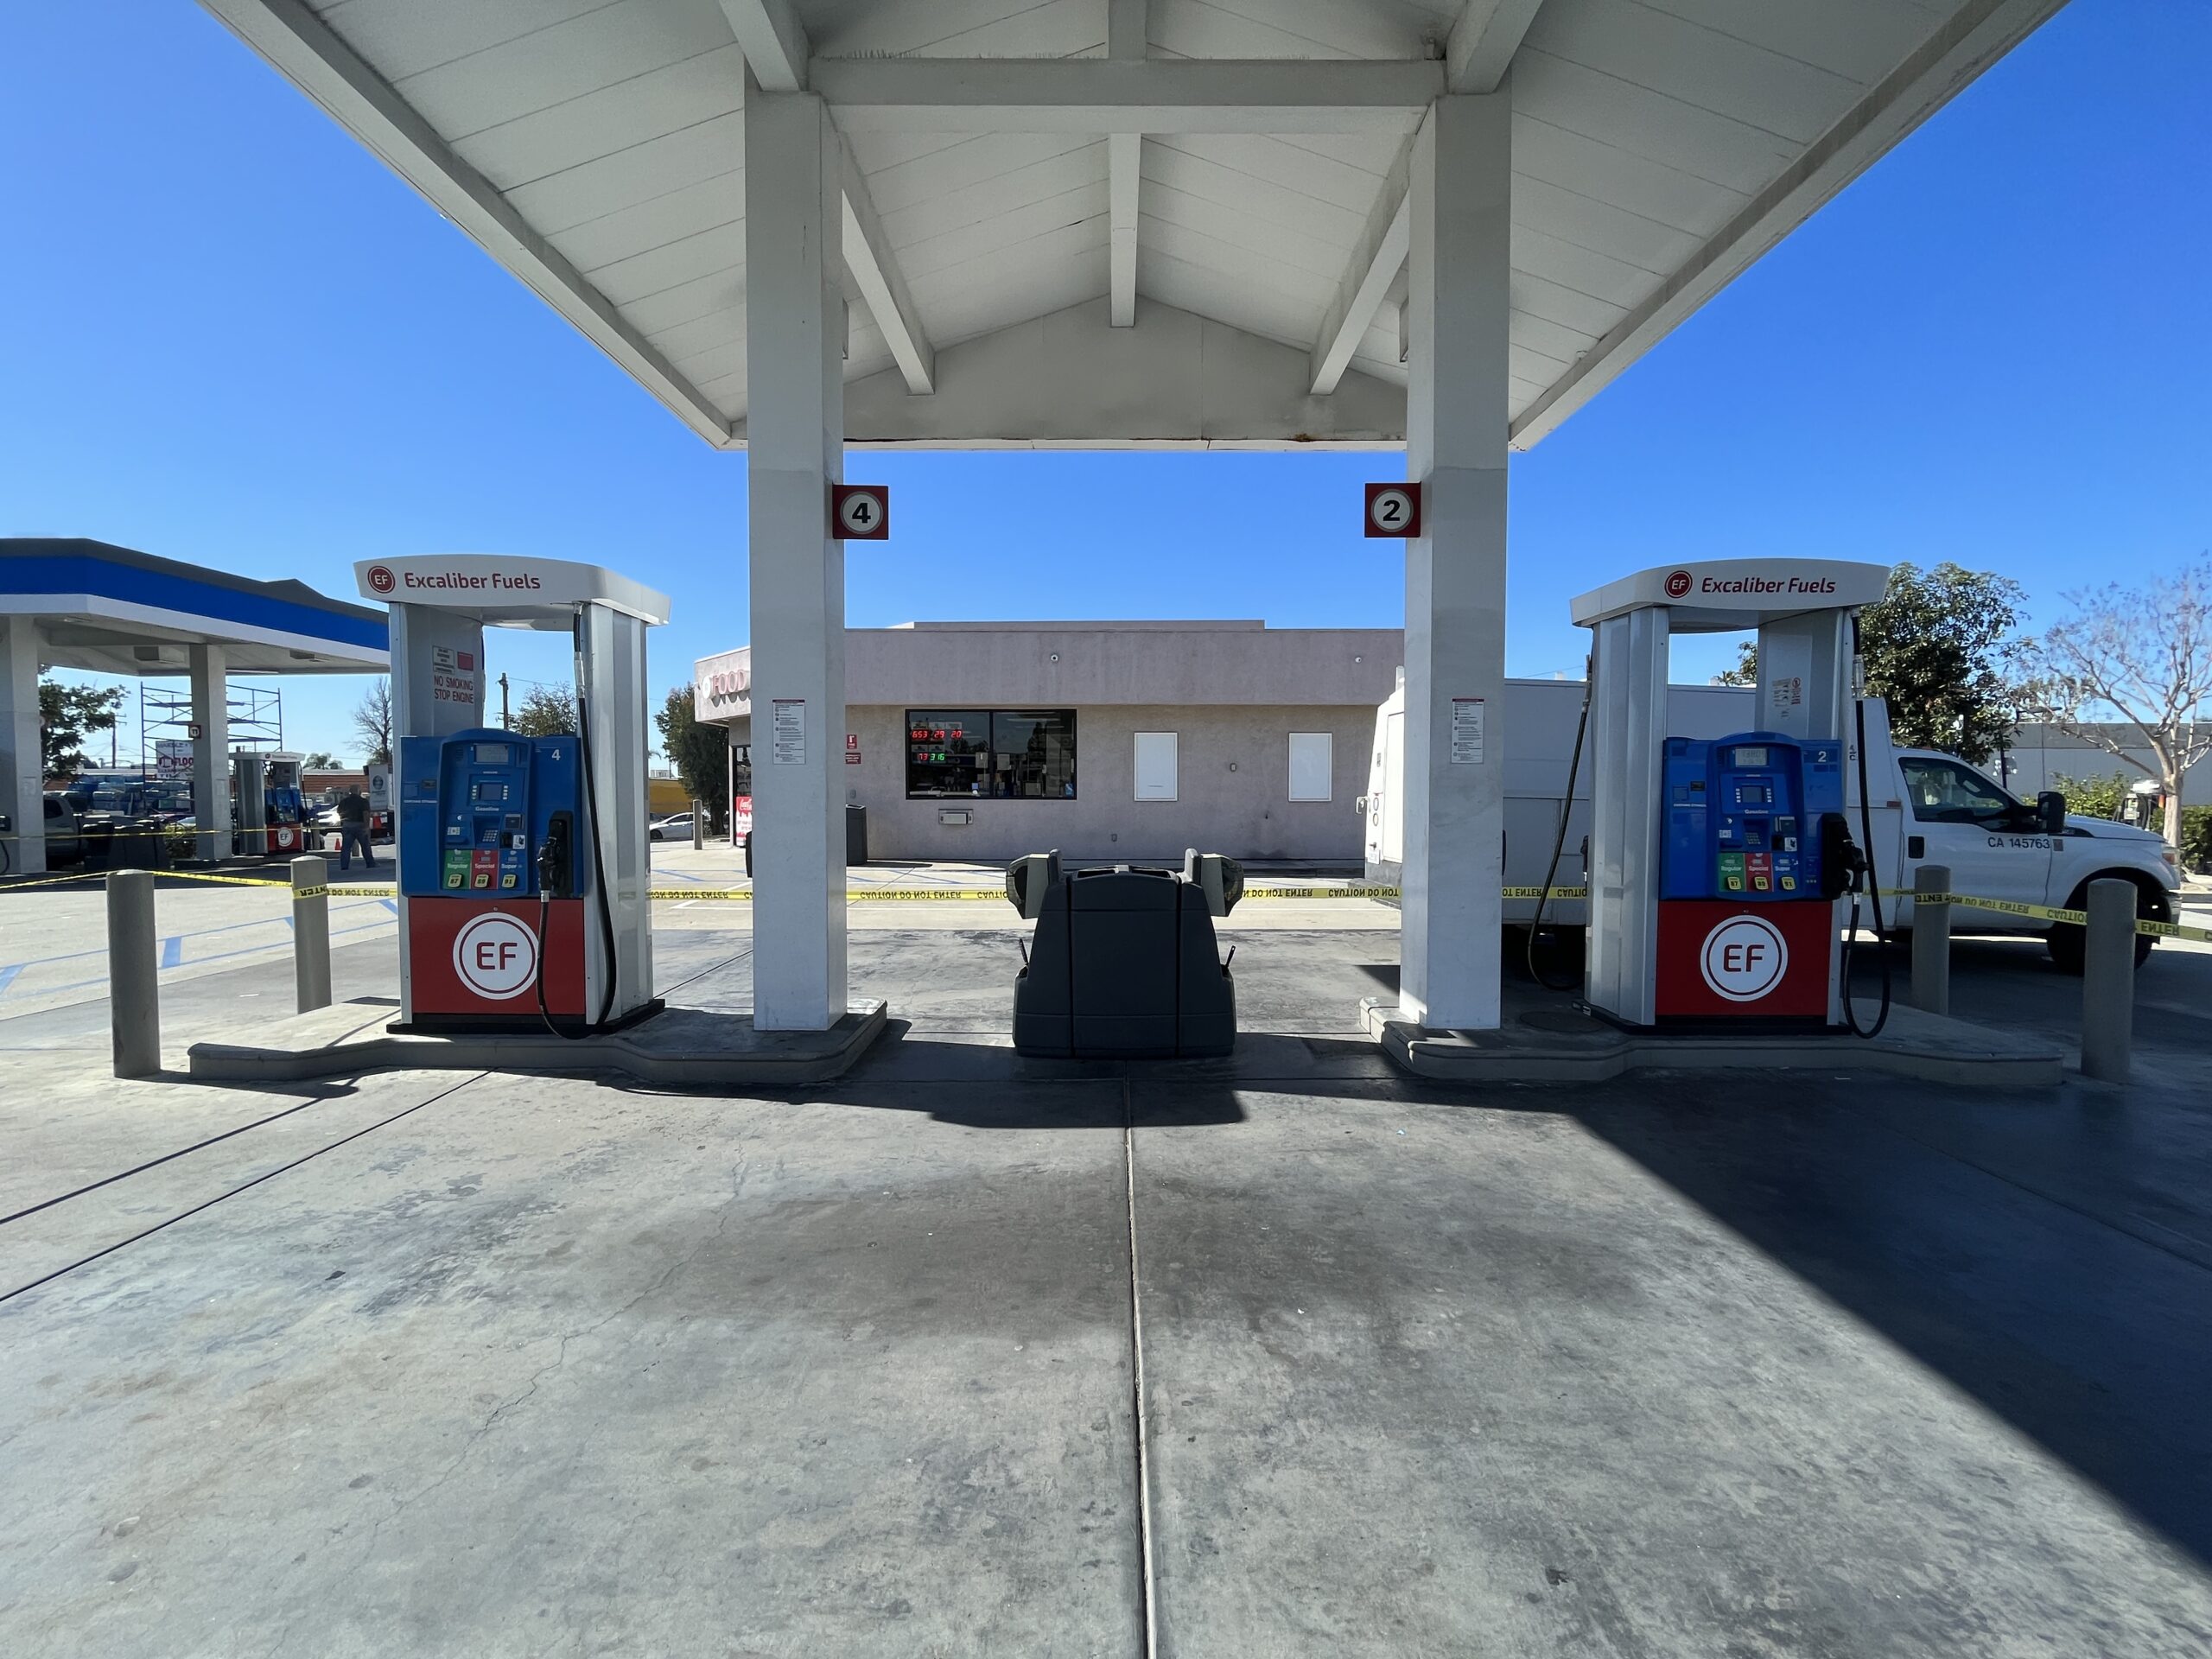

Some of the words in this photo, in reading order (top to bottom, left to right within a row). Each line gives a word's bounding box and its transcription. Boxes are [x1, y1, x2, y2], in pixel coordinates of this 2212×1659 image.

[851, 502, 872, 524] 4
[1382, 499, 1401, 522] 2
[374, 575, 389, 585] EF
[404, 572, 487, 588] Excaliber
[492, 573, 541, 589] Fuels
[1671, 580, 1686, 590] EF
[1701, 577, 1785, 594] Excaliber
[1788, 577, 1836, 594] Fuels
[434, 675, 444, 687] NO
[446, 677, 474, 691] SMOKING
[712, 670, 747, 696] FOOD
[434, 688, 451, 701] STOP
[452, 690, 474, 704] ENGINE
[912, 730, 928, 739] 653
[934, 730, 944, 739] 29
[950, 730, 962, 739] 20
[551, 748, 561, 761] 4
[1817, 750, 1827, 762] 2
[1987, 836, 2005, 848] CA
[2009, 838, 2050, 849] 145763
[300, 886, 327, 897] NTER
[476, 941, 518, 970] EF
[1723, 944, 1765, 973] EF
